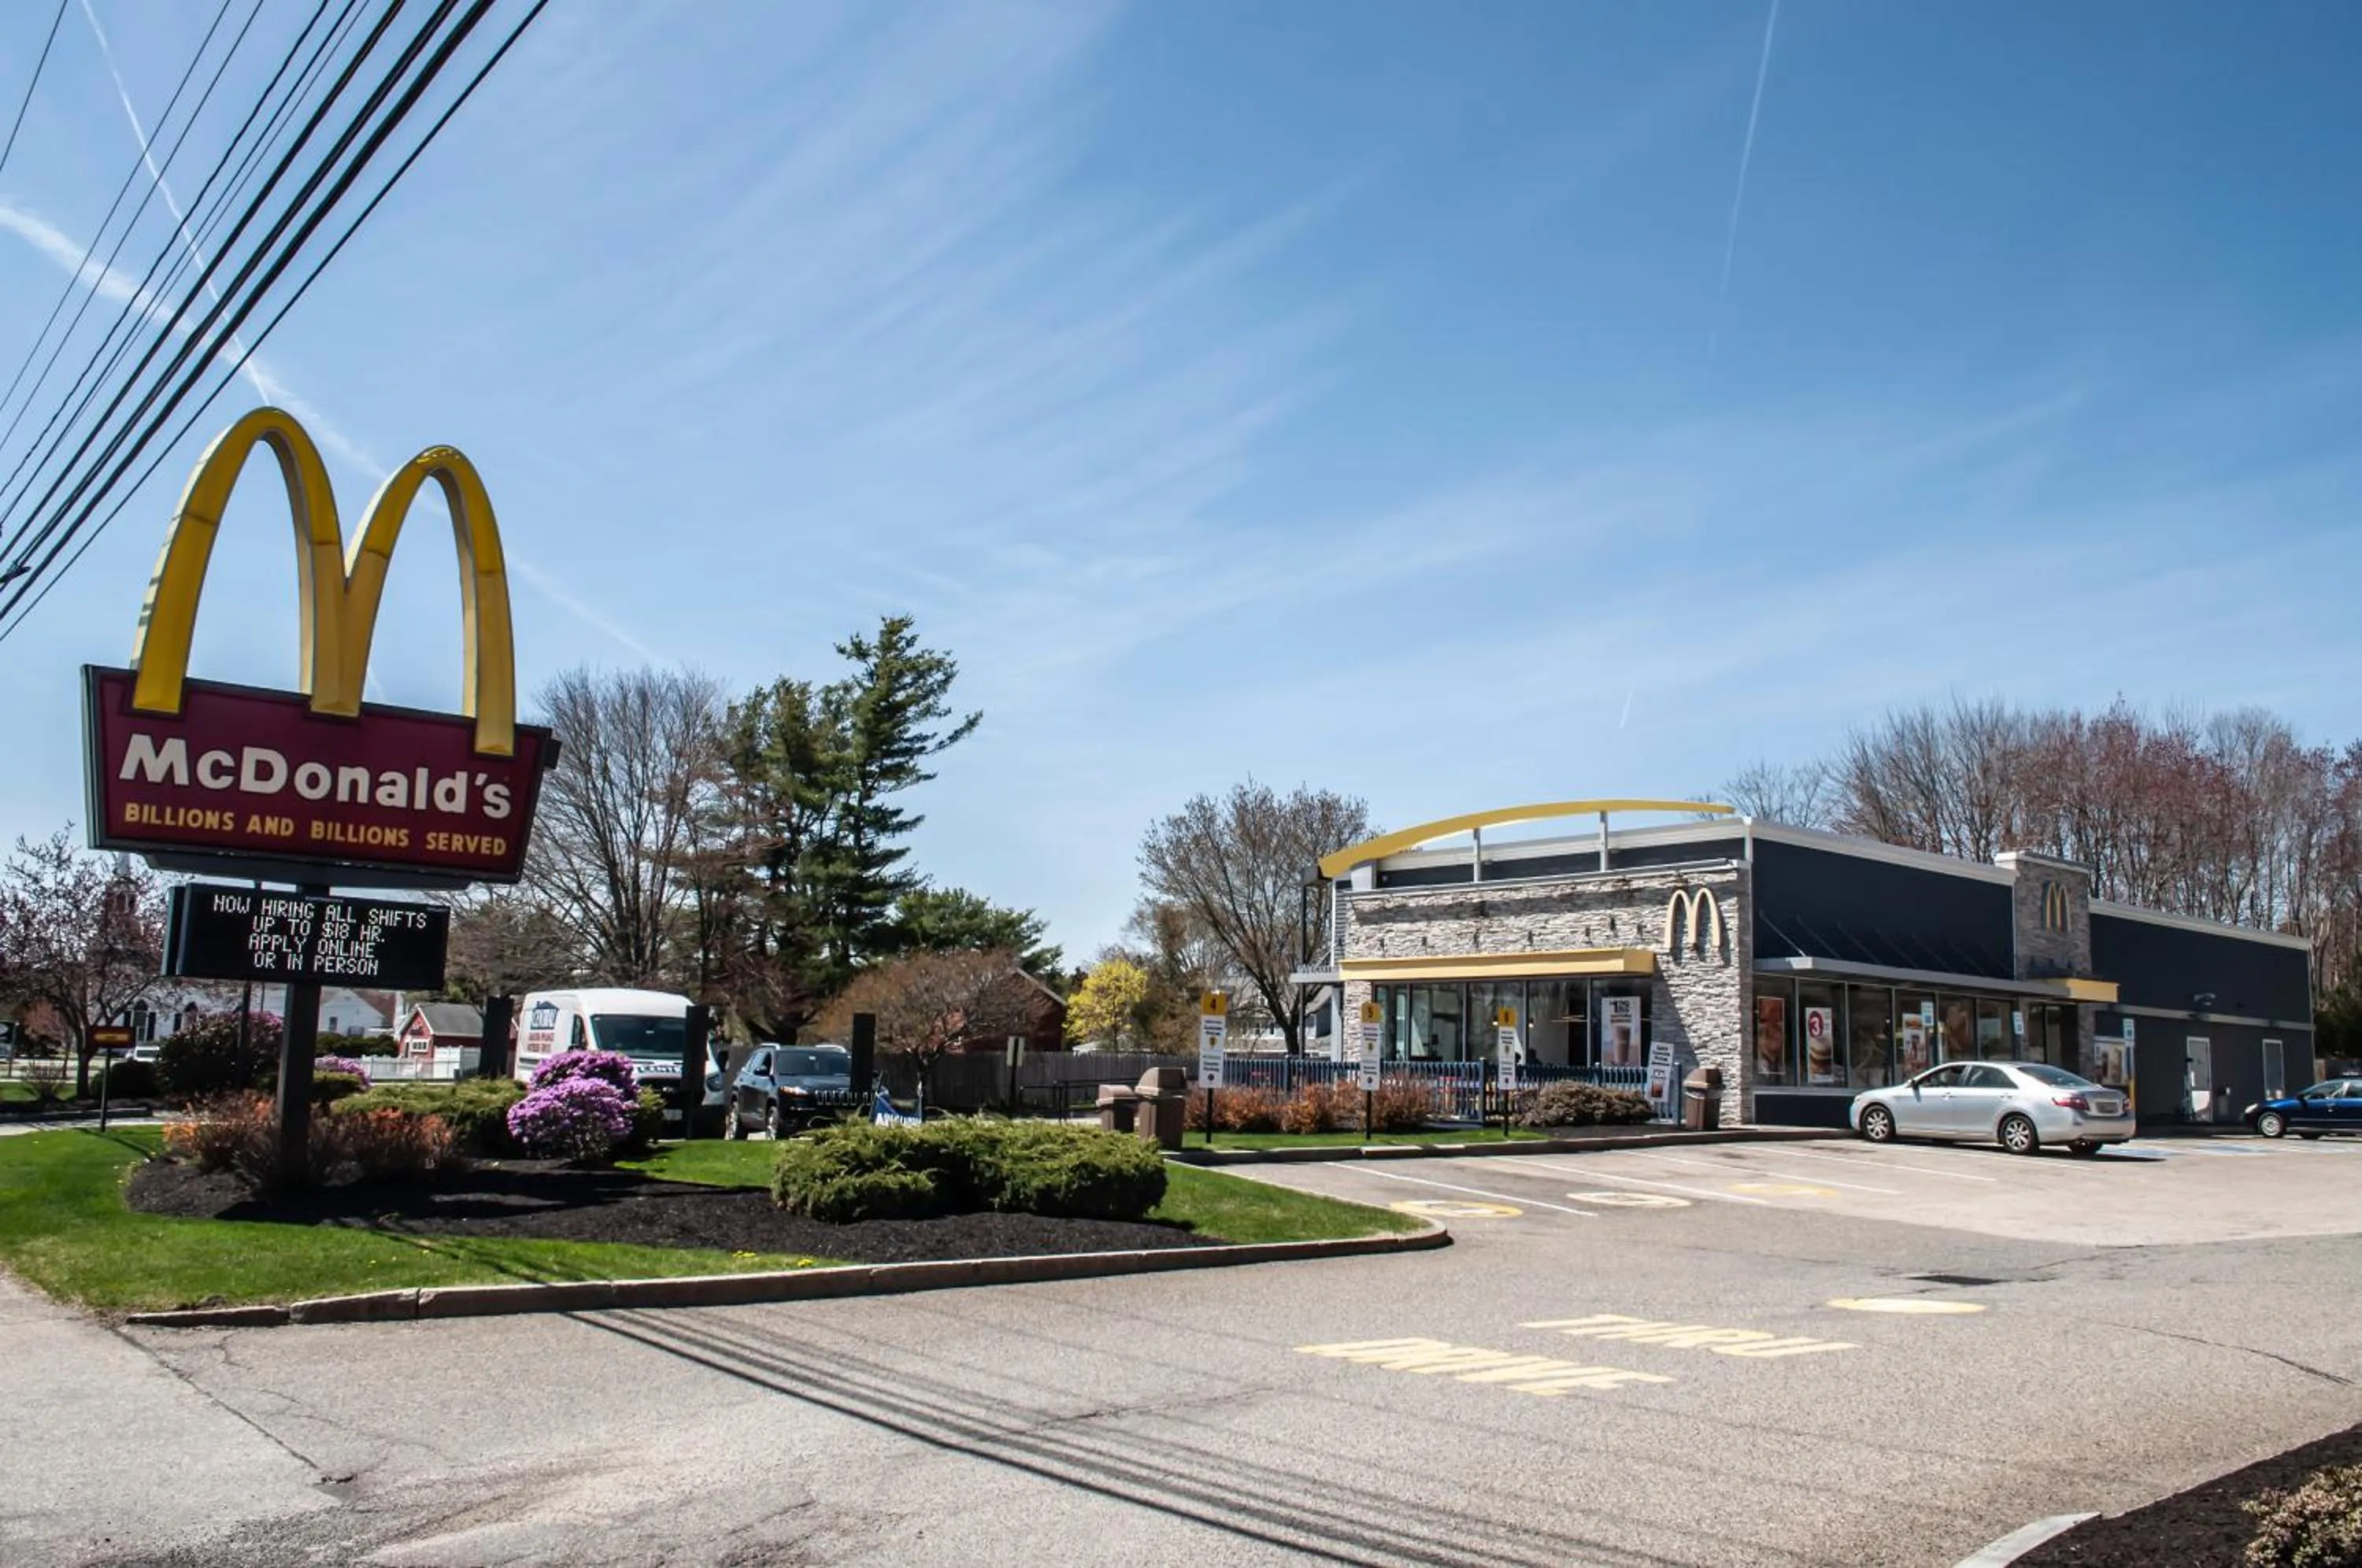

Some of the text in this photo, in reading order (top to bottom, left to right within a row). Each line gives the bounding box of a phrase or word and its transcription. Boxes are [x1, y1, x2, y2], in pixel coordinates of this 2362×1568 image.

[119, 733, 512, 819] McDonald's
[124, 802, 507, 856] BILLIONS AND BILLIONS SERVED
[213, 893, 427, 930] NOW HIRING ALL SHIFTS
[252, 915, 386, 943] UP TO $18 HR.
[248, 932, 376, 959] APPLY ONLINE
[253, 950, 379, 976] OR IN PERSON
[1518, 1314, 1863, 1358] THRU
[1292, 1337, 1678, 1397] DRIVE
